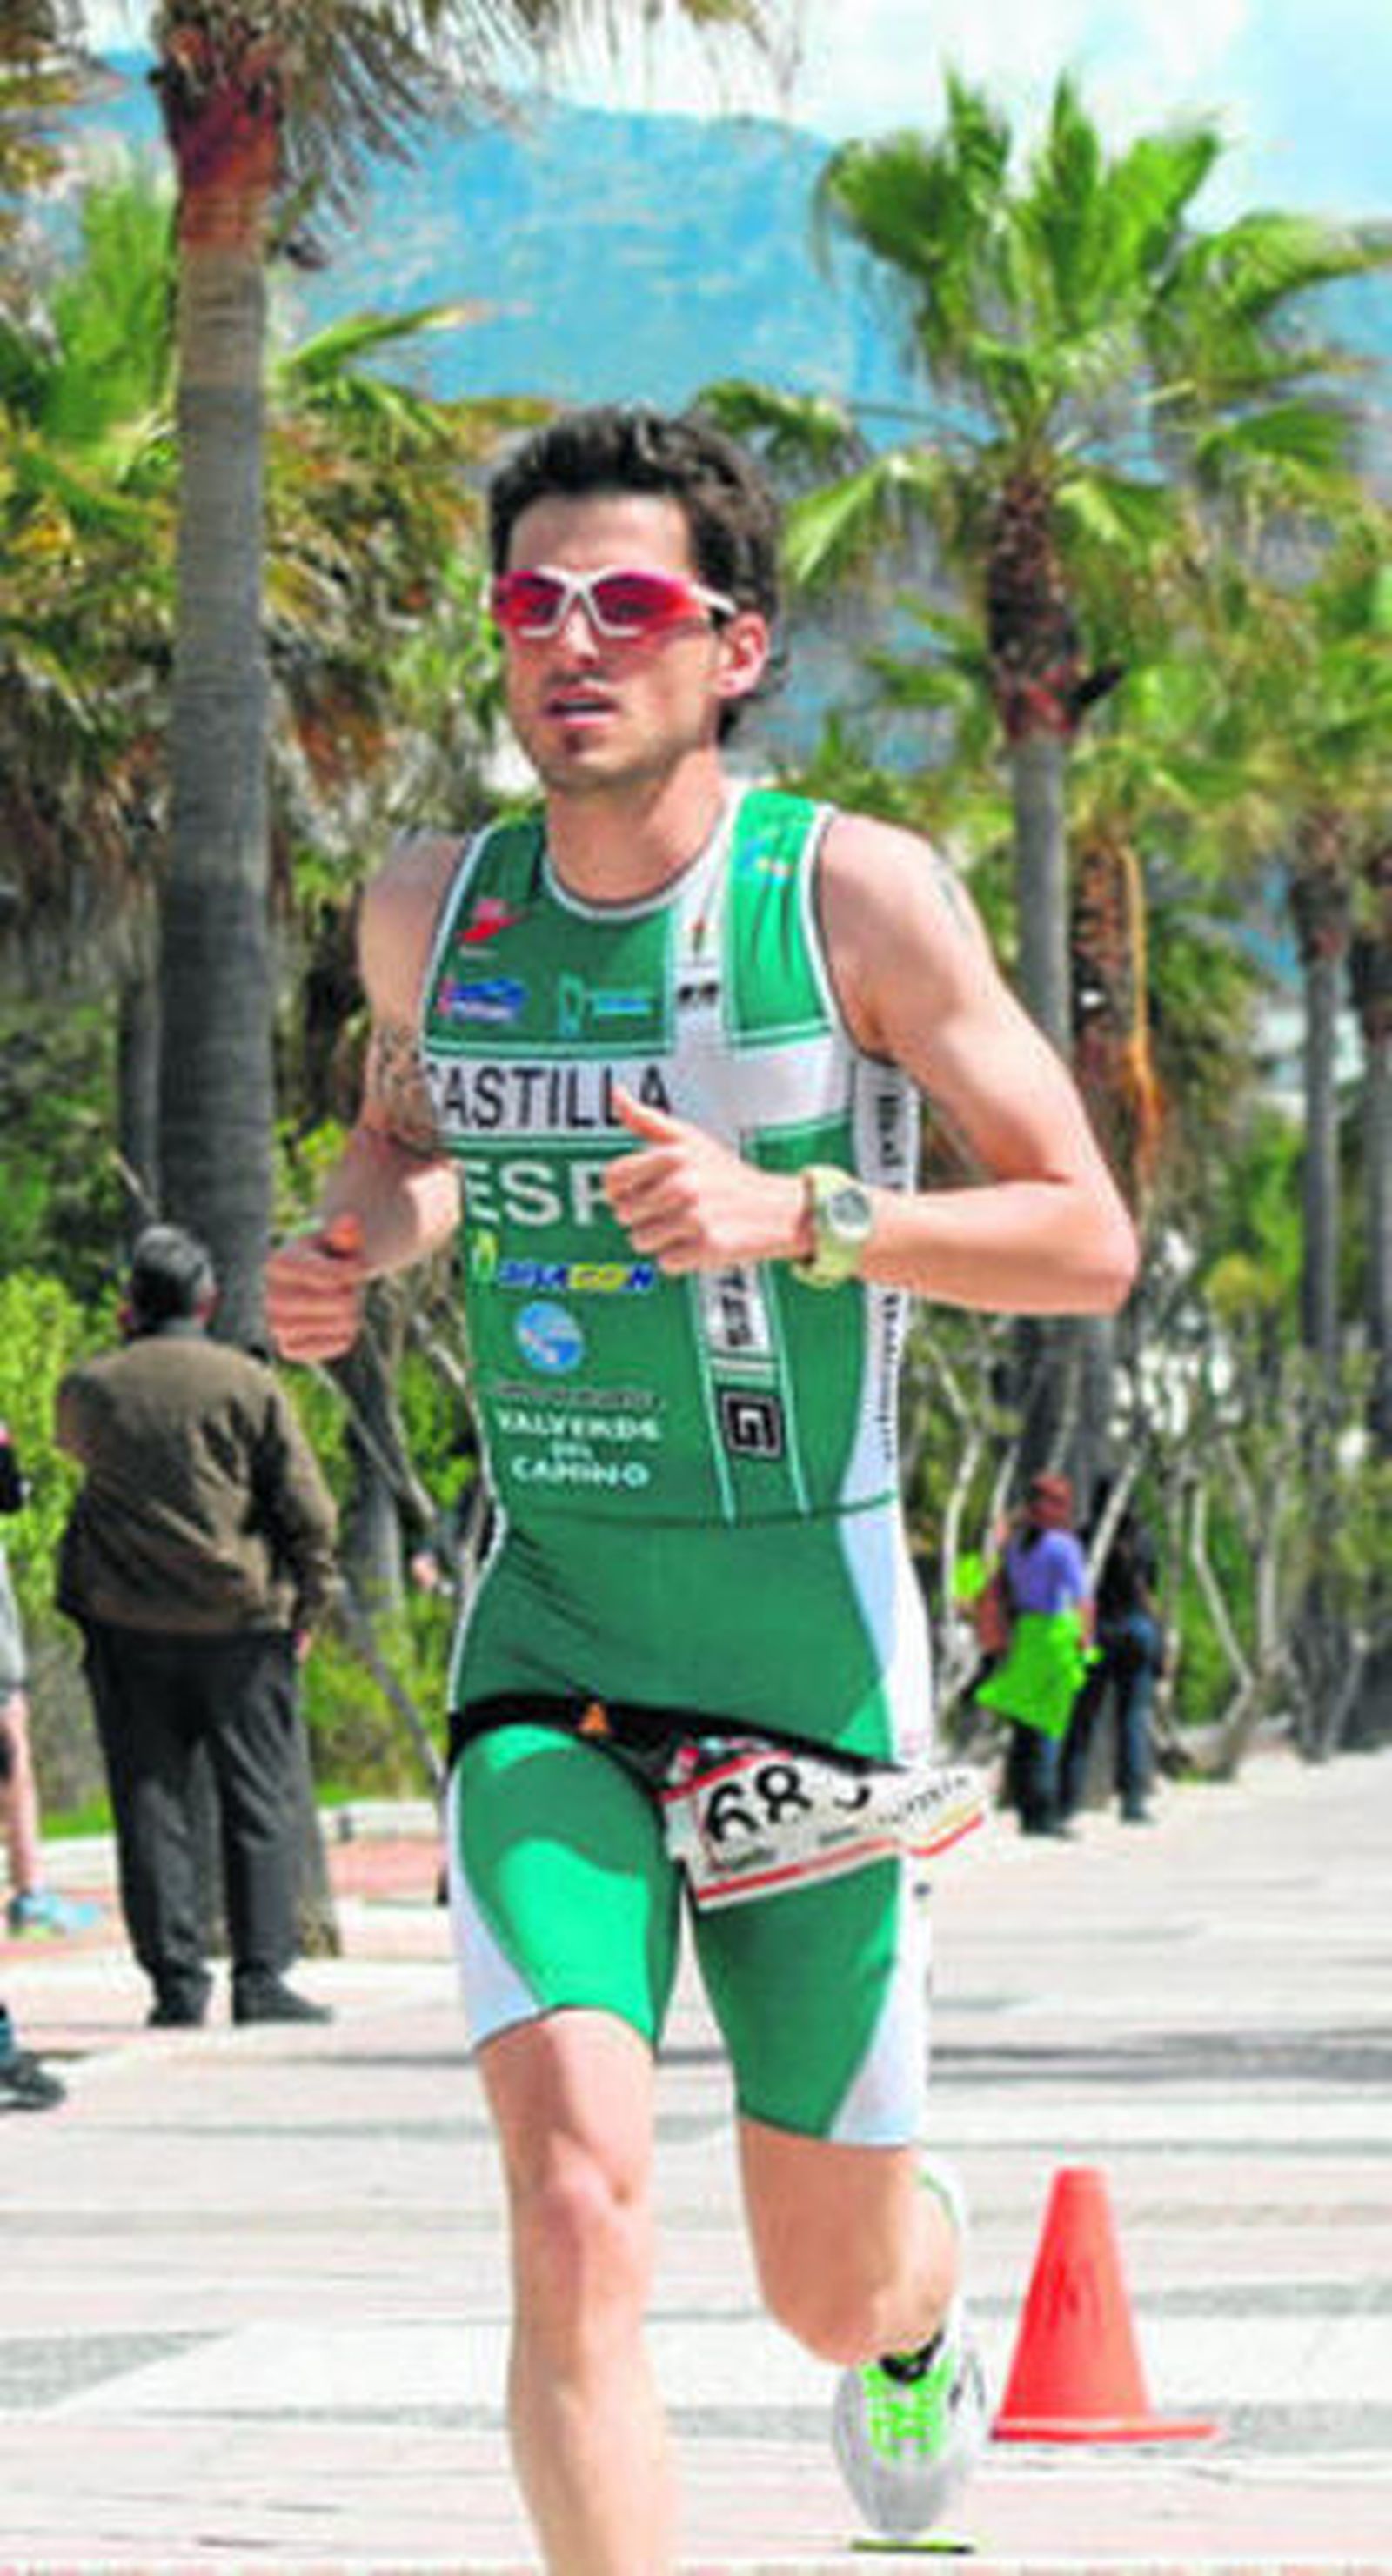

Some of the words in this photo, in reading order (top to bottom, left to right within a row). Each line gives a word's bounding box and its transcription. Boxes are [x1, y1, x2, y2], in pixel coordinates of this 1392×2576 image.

[426, 1064, 671, 1129] ASTILLA
[495, 1408, 661, 1441] VALVERDE
[510, 1456, 651, 1489] CAMINO
